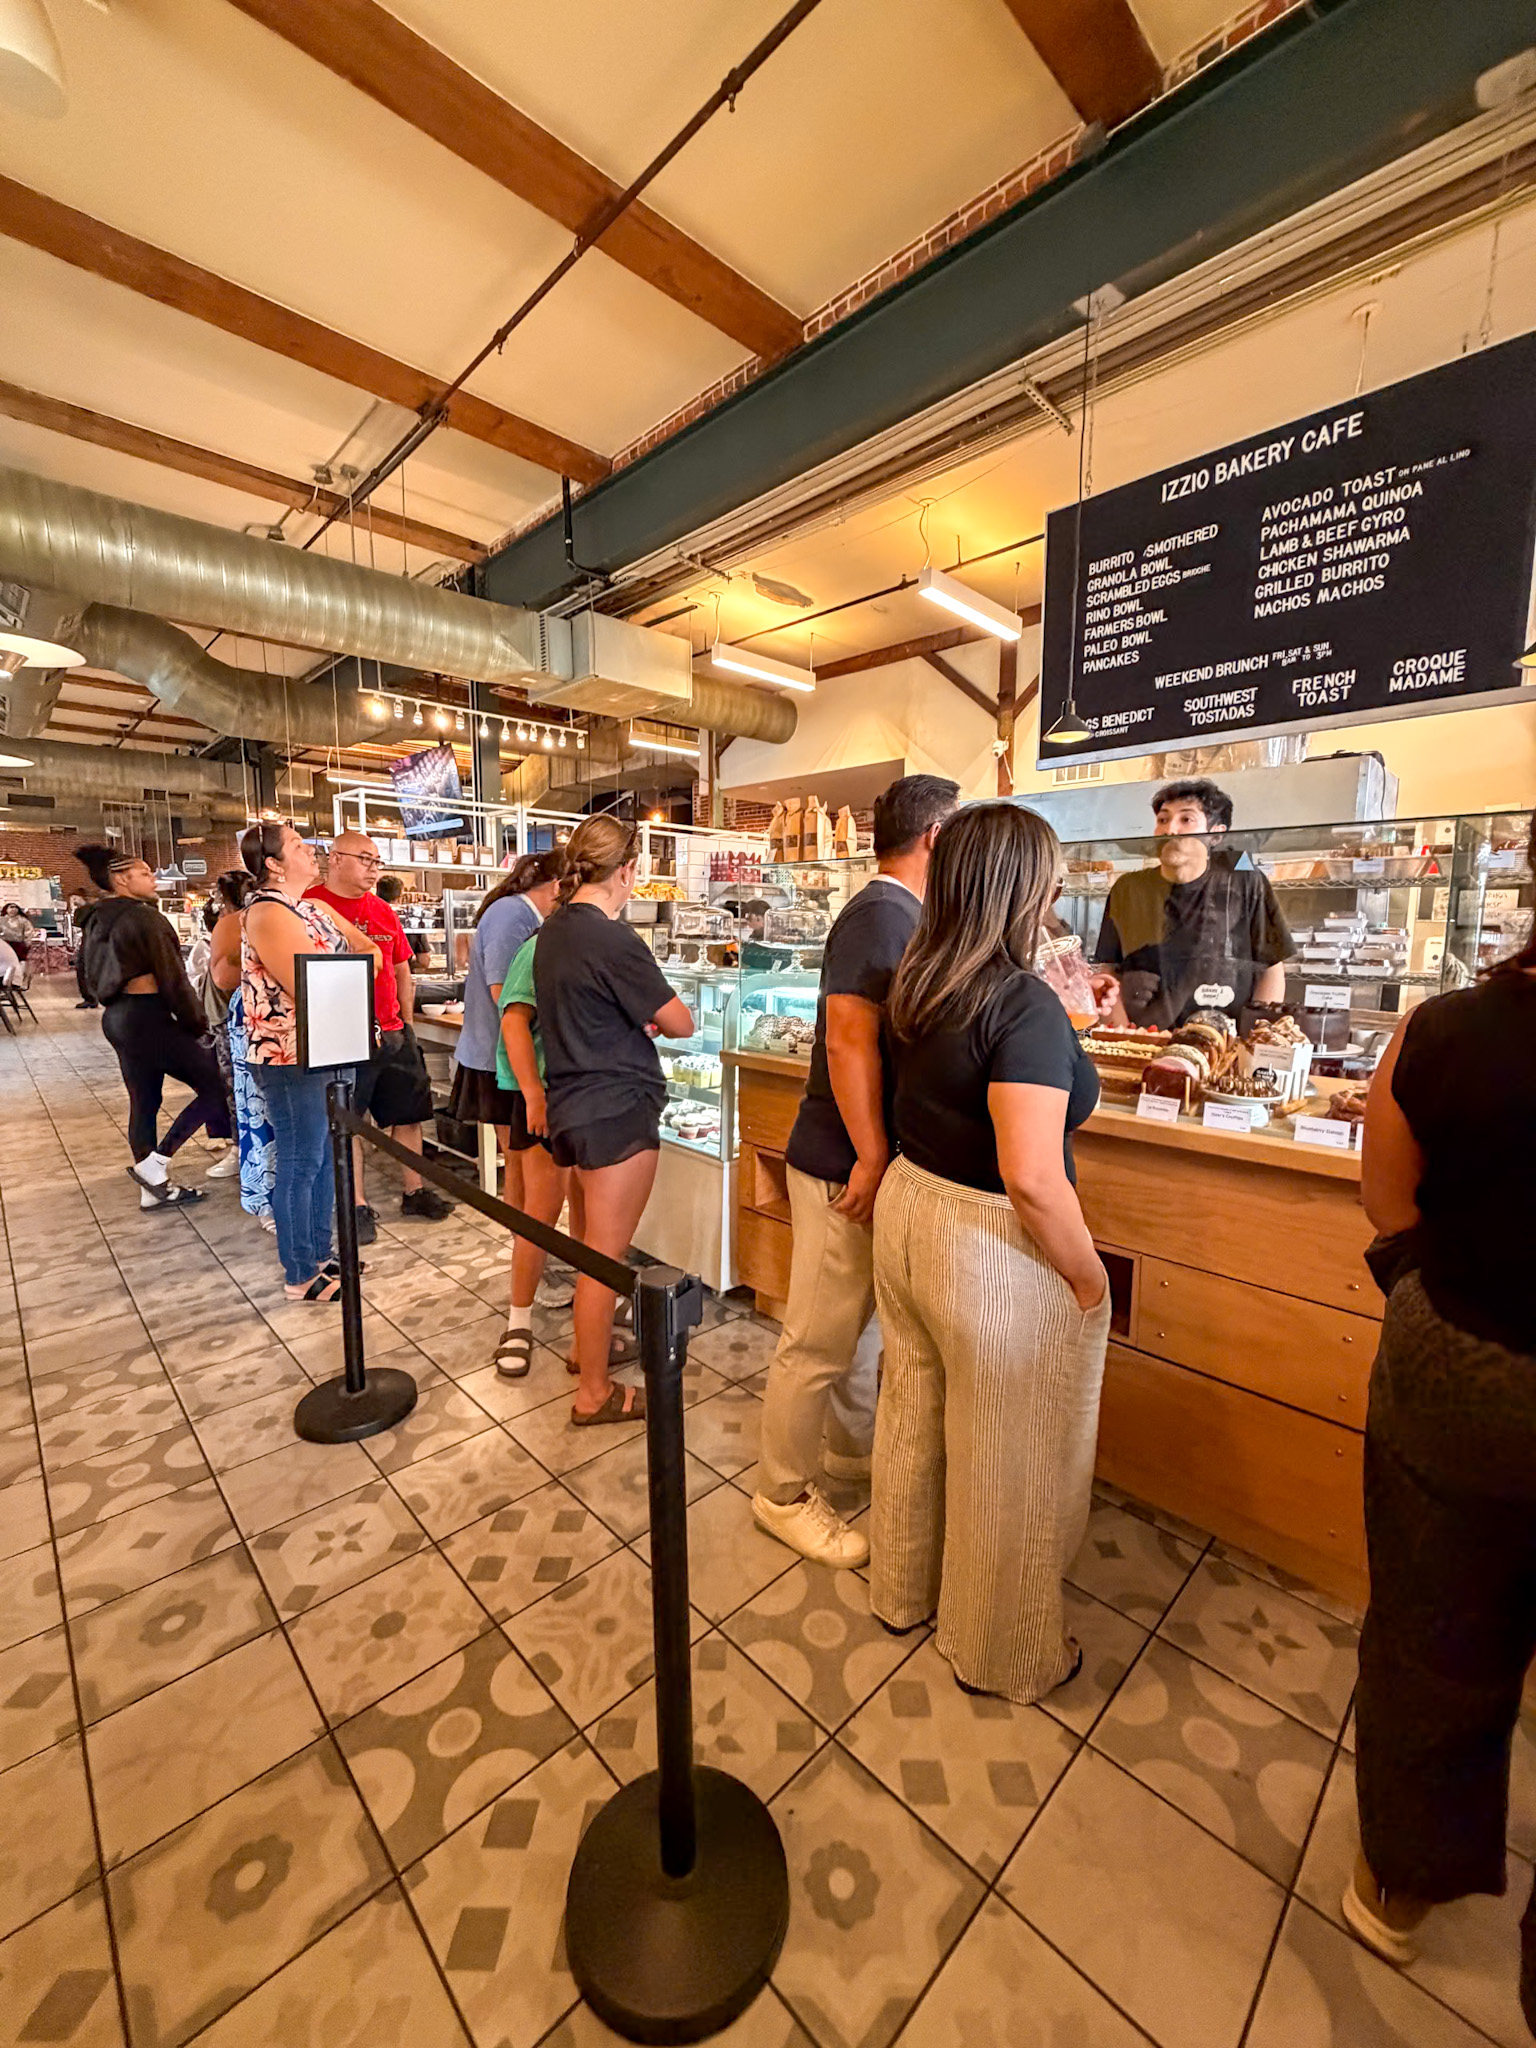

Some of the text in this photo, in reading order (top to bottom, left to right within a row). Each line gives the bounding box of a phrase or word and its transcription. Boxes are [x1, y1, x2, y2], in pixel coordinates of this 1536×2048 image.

[1161, 411, 1365, 504] IZZIO BAKERY CAFE
[1398, 468, 1410, 478] ON
[1411, 460, 1434, 473] PANE
[1436, 456, 1448, 467] AL
[1261, 466, 1397, 523] AVOCADO TOAST
[1260, 480, 1423, 542] PACHAMAMA QUINOA
[1259, 507, 1406, 561] LAMB & BEEF GYRO
[1088, 550, 1135, 576] BURRITO
[1257, 526, 1411, 580] CHICKEN SHAWARMA
[1086, 556, 1173, 593] GRANOLA BOWL
[1254, 552, 1391, 600] GRILLED BURRITO
[1086, 570, 1181, 608] SCRAMBLED EGGS
[1253, 574, 1386, 619] NACHOS MACHOS
[1084, 609, 1168, 641] FARMERS BOWL
[1085, 598, 1144, 625] RINO BOWL
[1083, 630, 1153, 658] PALEO BOWL
[1304, 645, 1312, 654] &
[1312, 641, 1330, 652] SUN
[1082, 650, 1141, 675] PANCAKES
[1154, 653, 1269, 690] WEEKEND BRUNCH
[1281, 649, 1333, 667] 8AM TO 3PM
[1392, 649, 1467, 676] CROQUE
[1292, 669, 1357, 694] FRENCH
[1389, 664, 1466, 693] MADAME
[1183, 687, 1258, 712] SOUTHWEST
[1297, 684, 1352, 707] TOAST
[1102, 707, 1155, 728] BENEDICT
[1189, 703, 1256, 727] TOSTADAS
[1094, 726, 1129, 738] CROISSANT
